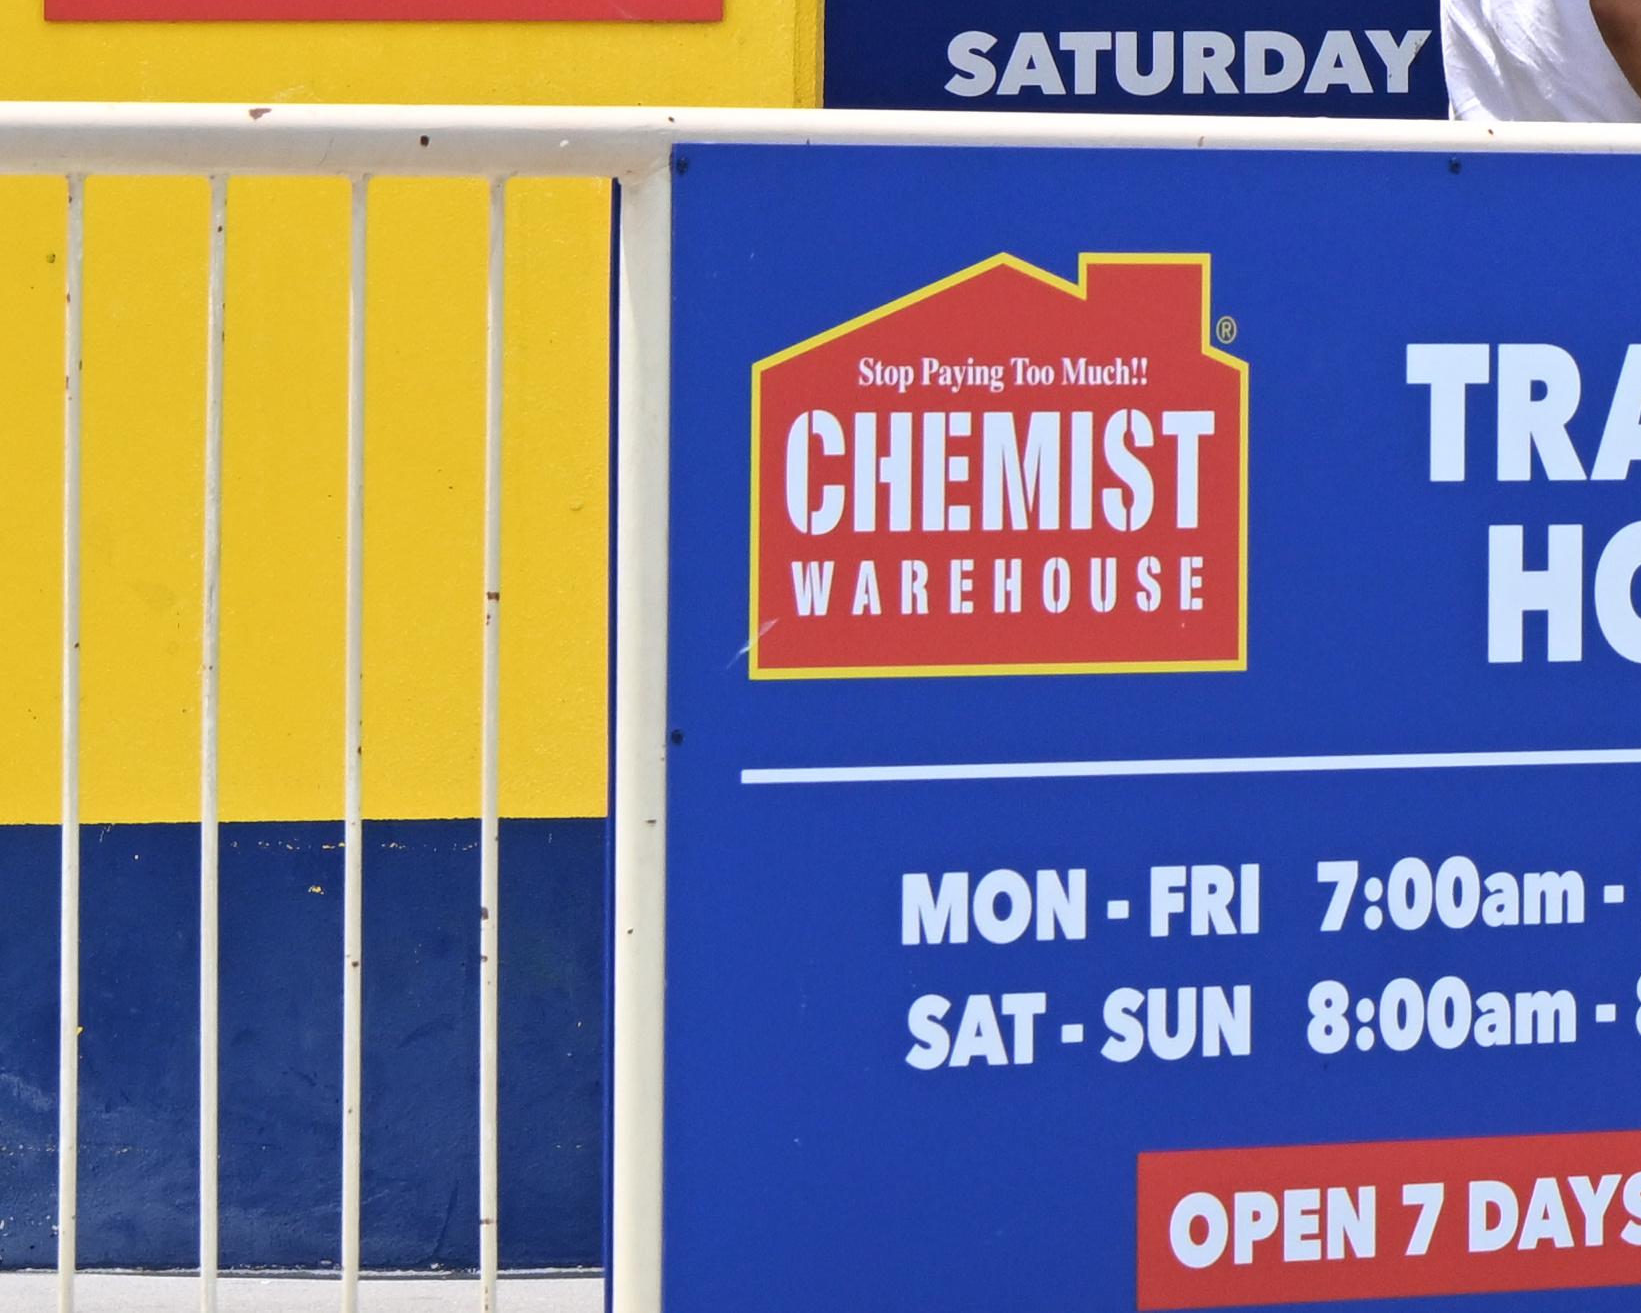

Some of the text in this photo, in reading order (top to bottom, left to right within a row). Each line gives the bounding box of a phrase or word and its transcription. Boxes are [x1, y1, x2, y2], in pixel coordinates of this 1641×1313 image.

[944, 29, 1432, 97] SATURDAY
[858, 357, 1149, 392] Stop Paying Too Much!!
[785, 408, 1216, 536] CHEMIST
[790, 555, 1204, 617] WAREHOUSE
[900, 868, 1088, 947] MON
[1148, 862, 1262, 938] FRI
[1315, 854, 1586, 933] 7:00am
[905, 992, 1047, 1072] SAT
[1100, 984, 1252, 1065] SUN
[1305, 974, 1577, 1056] 8:00am
[1168, 1185, 1377, 1270] OPEN
[1402, 1180, 1447, 1258] 7
